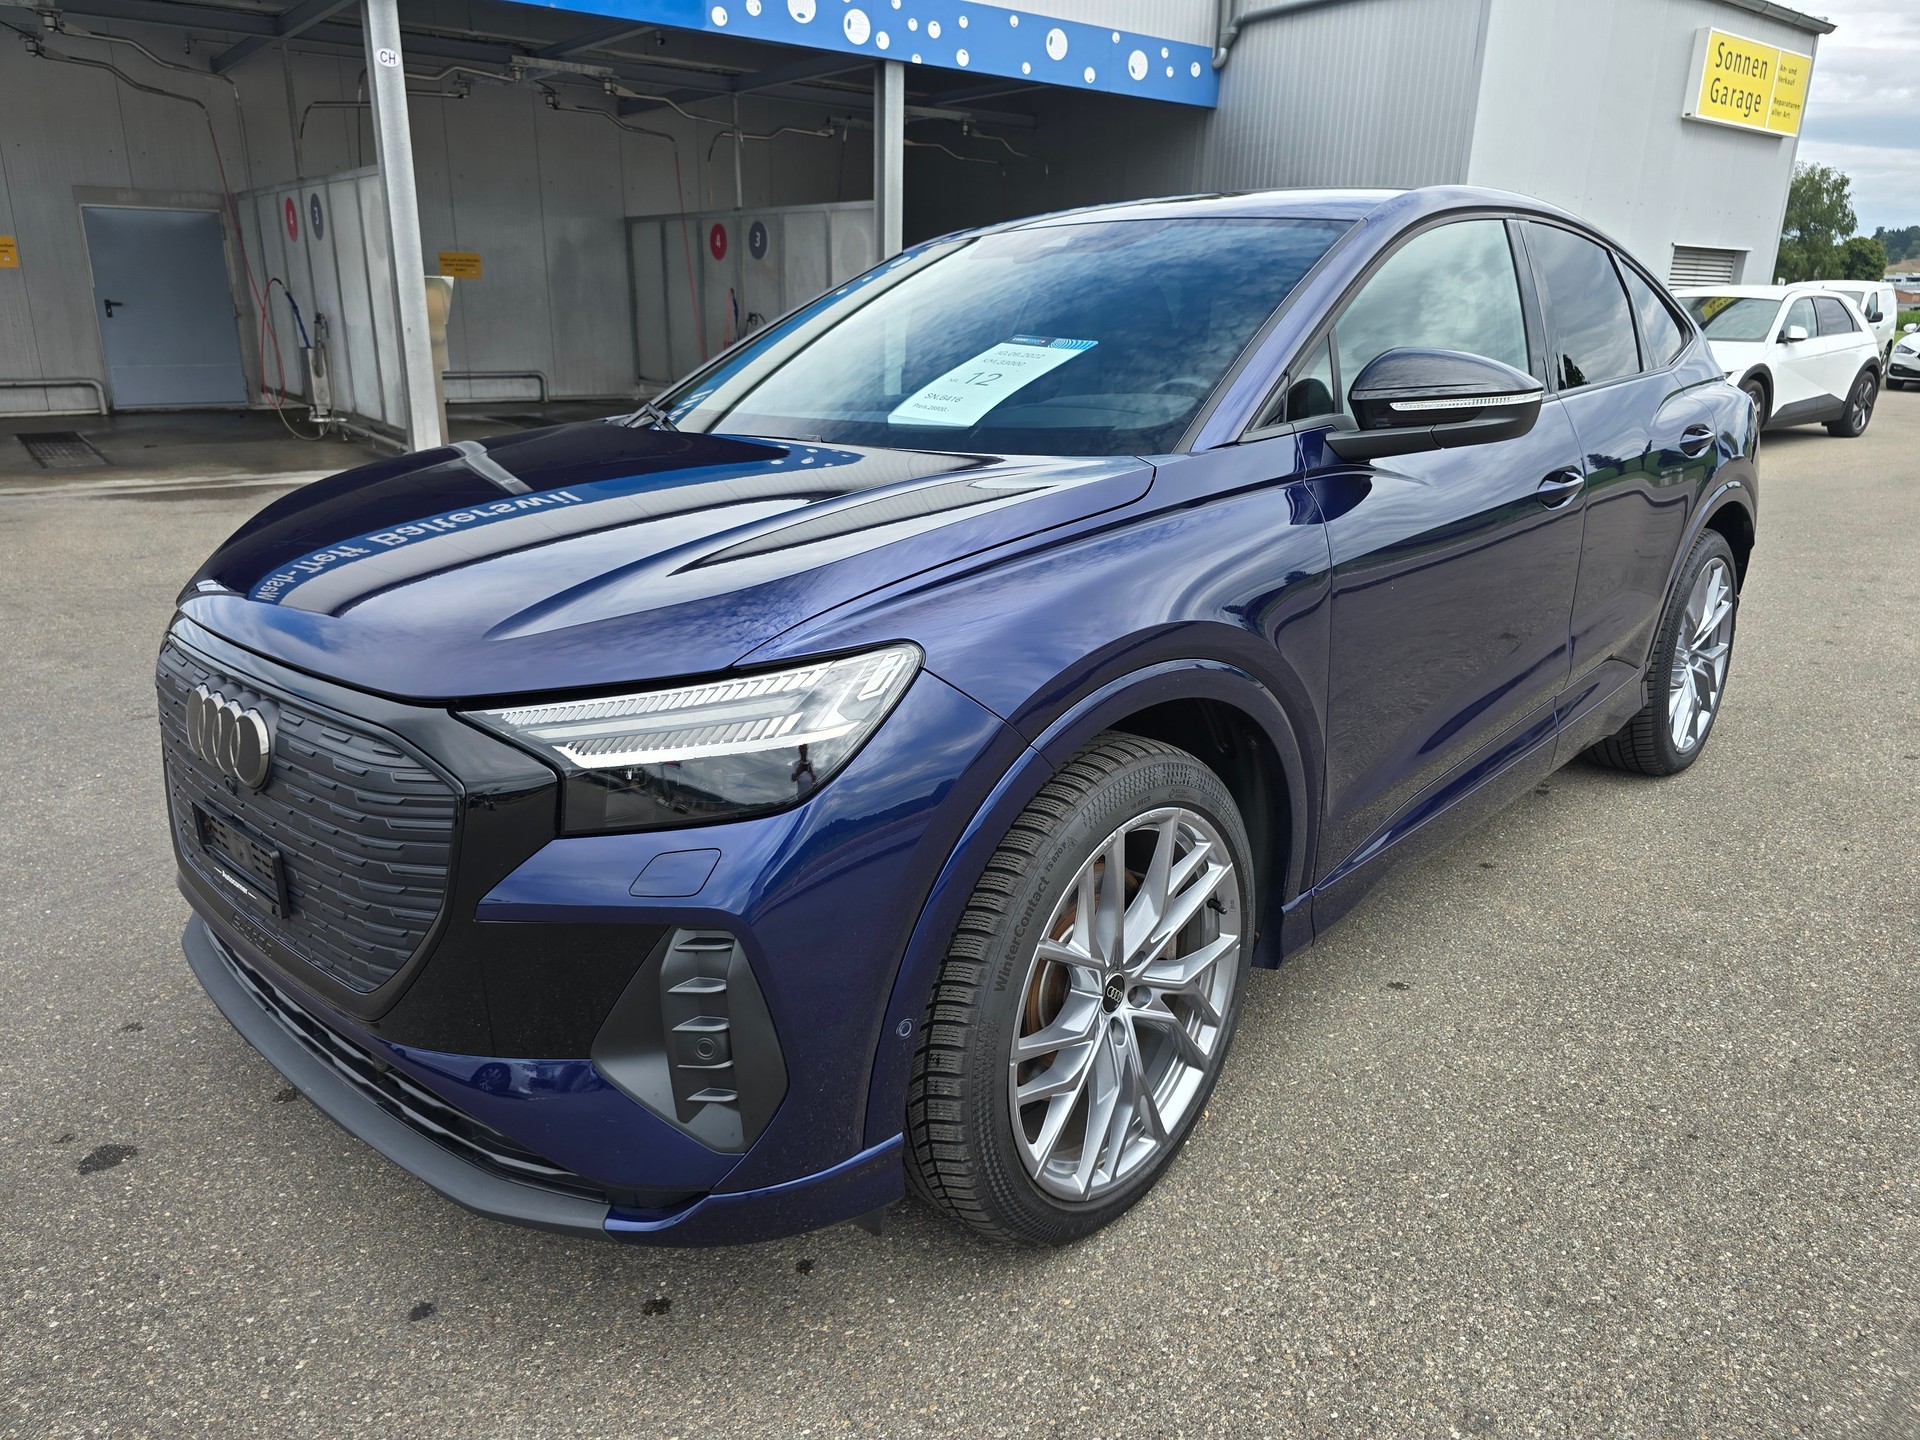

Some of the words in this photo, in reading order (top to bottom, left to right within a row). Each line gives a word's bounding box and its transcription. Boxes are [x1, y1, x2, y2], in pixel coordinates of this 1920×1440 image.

[380, 50, 397, 66] CH
[1715, 42, 1768, 80] Sonnen
[1777, 77, 1795, 86] Verkauf
[1710, 77, 1762, 118] Garage
[313, 206, 320, 225] 3
[715, 234, 721, 249] 4
[754, 231, 761, 247] 3
[964, 371, 1003, 387] 12
[924, 392, 964, 403] SN.6416
[994, 875, 1050, 994] WinterContact
[1045, 861, 1054, 873] TS
[1051, 847, 1066, 864] 870
